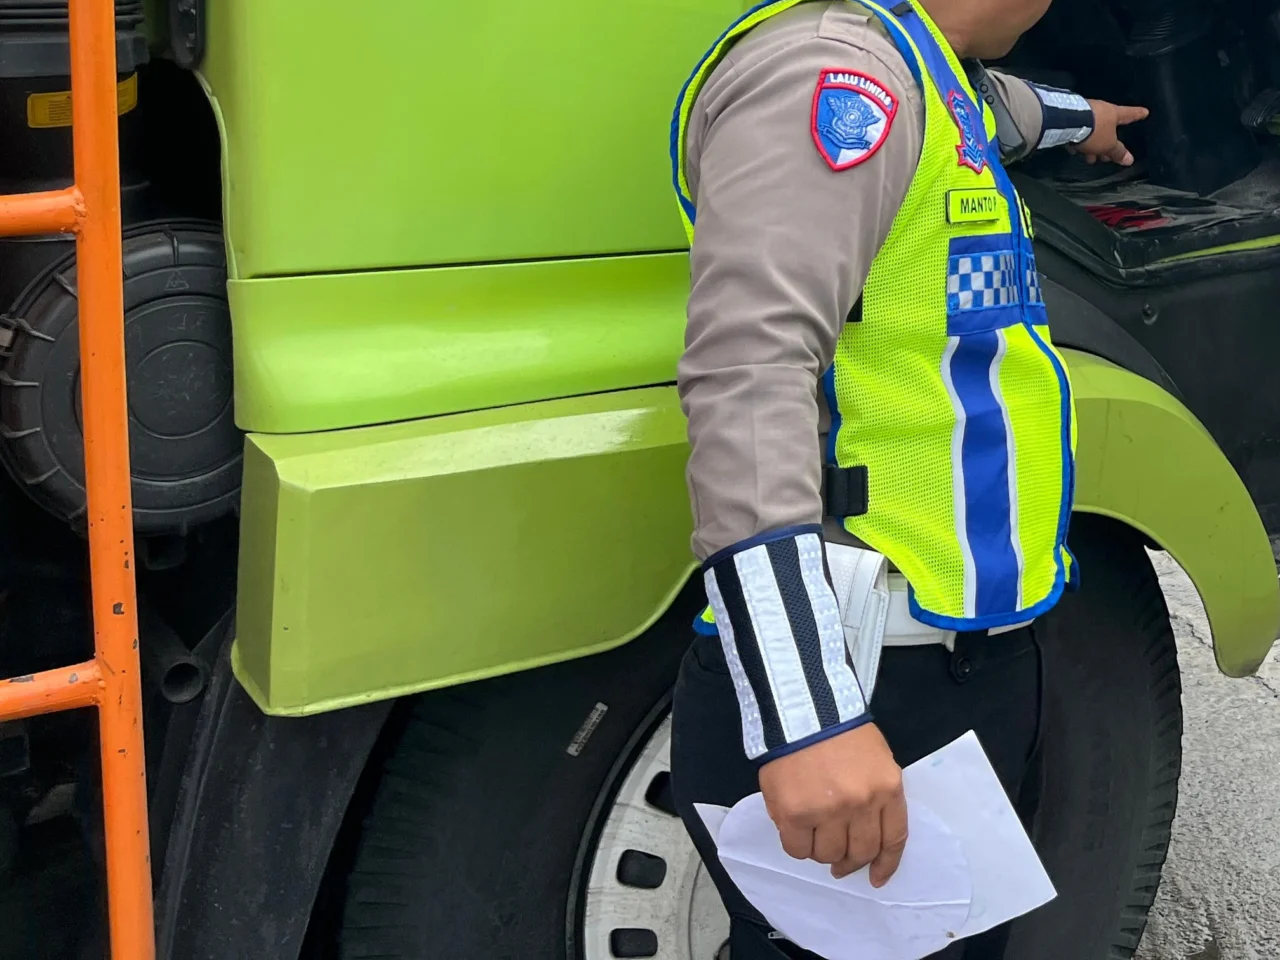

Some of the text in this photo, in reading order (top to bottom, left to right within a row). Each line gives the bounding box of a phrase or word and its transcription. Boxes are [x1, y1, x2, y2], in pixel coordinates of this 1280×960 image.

[829, 73, 892, 106] LALU LINTAS
[960, 196, 992, 214] MANTO
